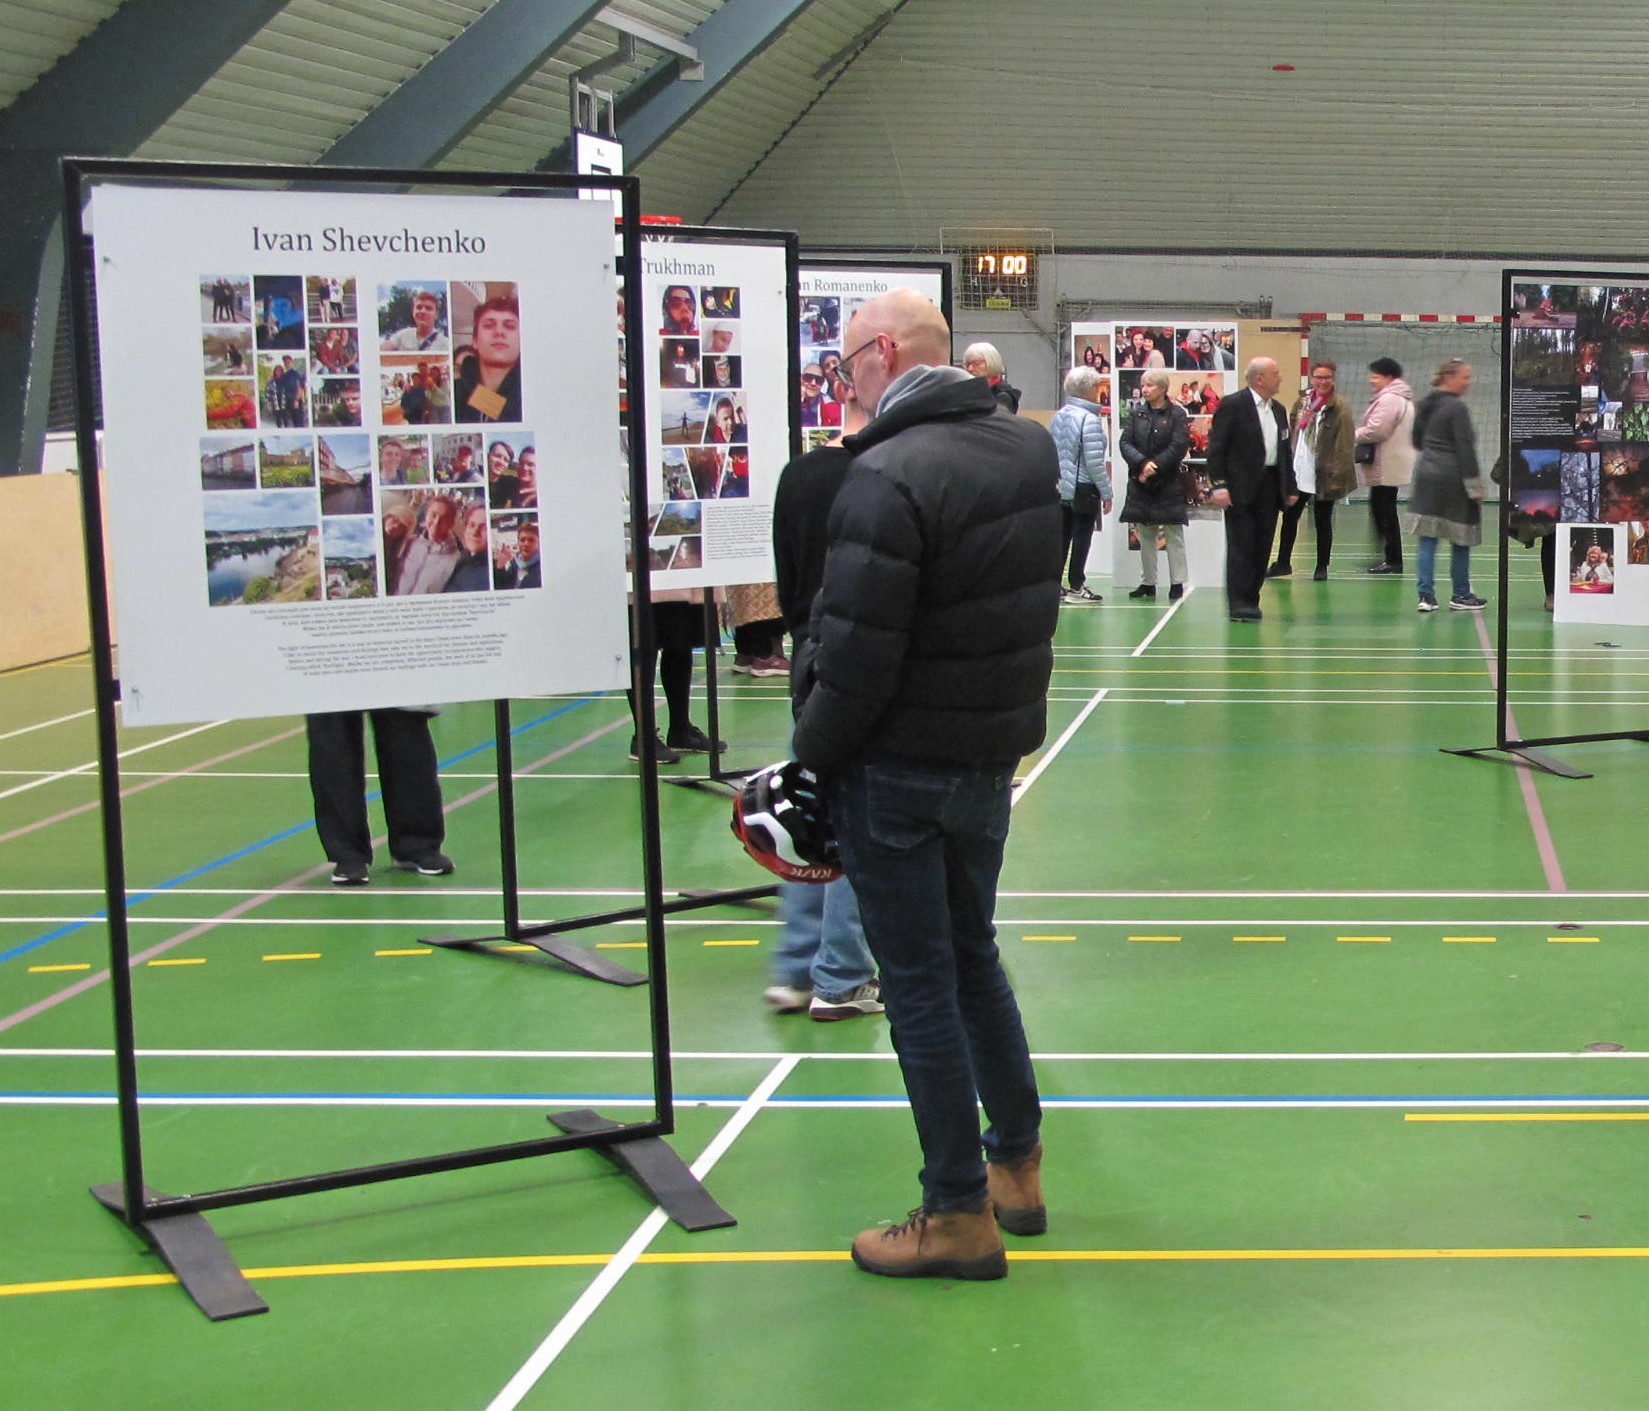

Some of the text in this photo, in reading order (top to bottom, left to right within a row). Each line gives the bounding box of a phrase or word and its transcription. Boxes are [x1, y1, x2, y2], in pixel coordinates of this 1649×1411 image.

[252, 226, 487, 254] Ivan Shevchenko
[814, 278, 888, 293] Romanenko
